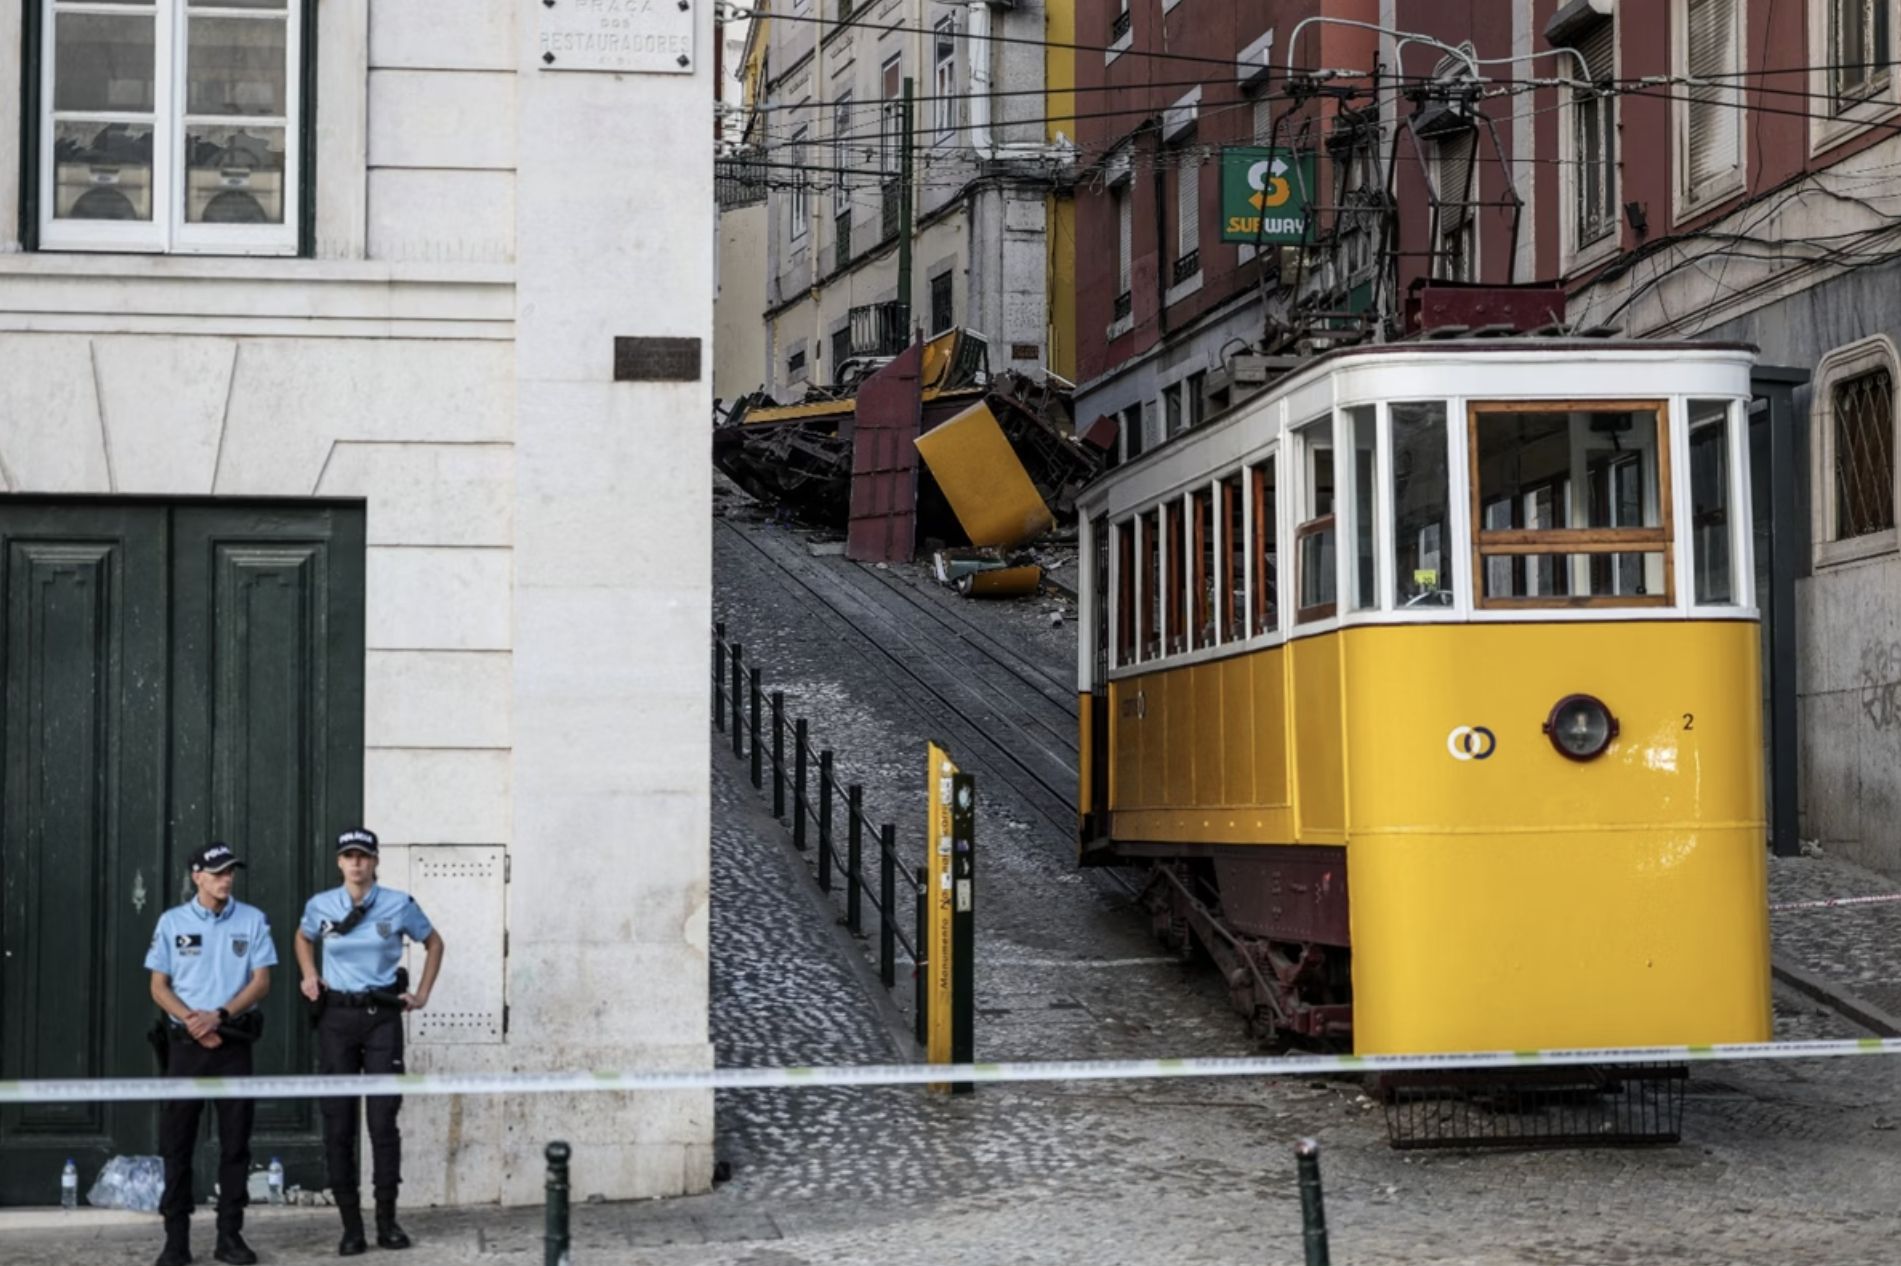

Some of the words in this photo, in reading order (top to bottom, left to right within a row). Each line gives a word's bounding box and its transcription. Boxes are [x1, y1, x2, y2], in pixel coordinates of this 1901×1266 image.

[540, 32, 689, 53] RESTAURADORES
[1226, 217, 1307, 234] SUBWAY
[1682, 712, 1694, 731] 2
[940, 917, 949, 990] Monumento
